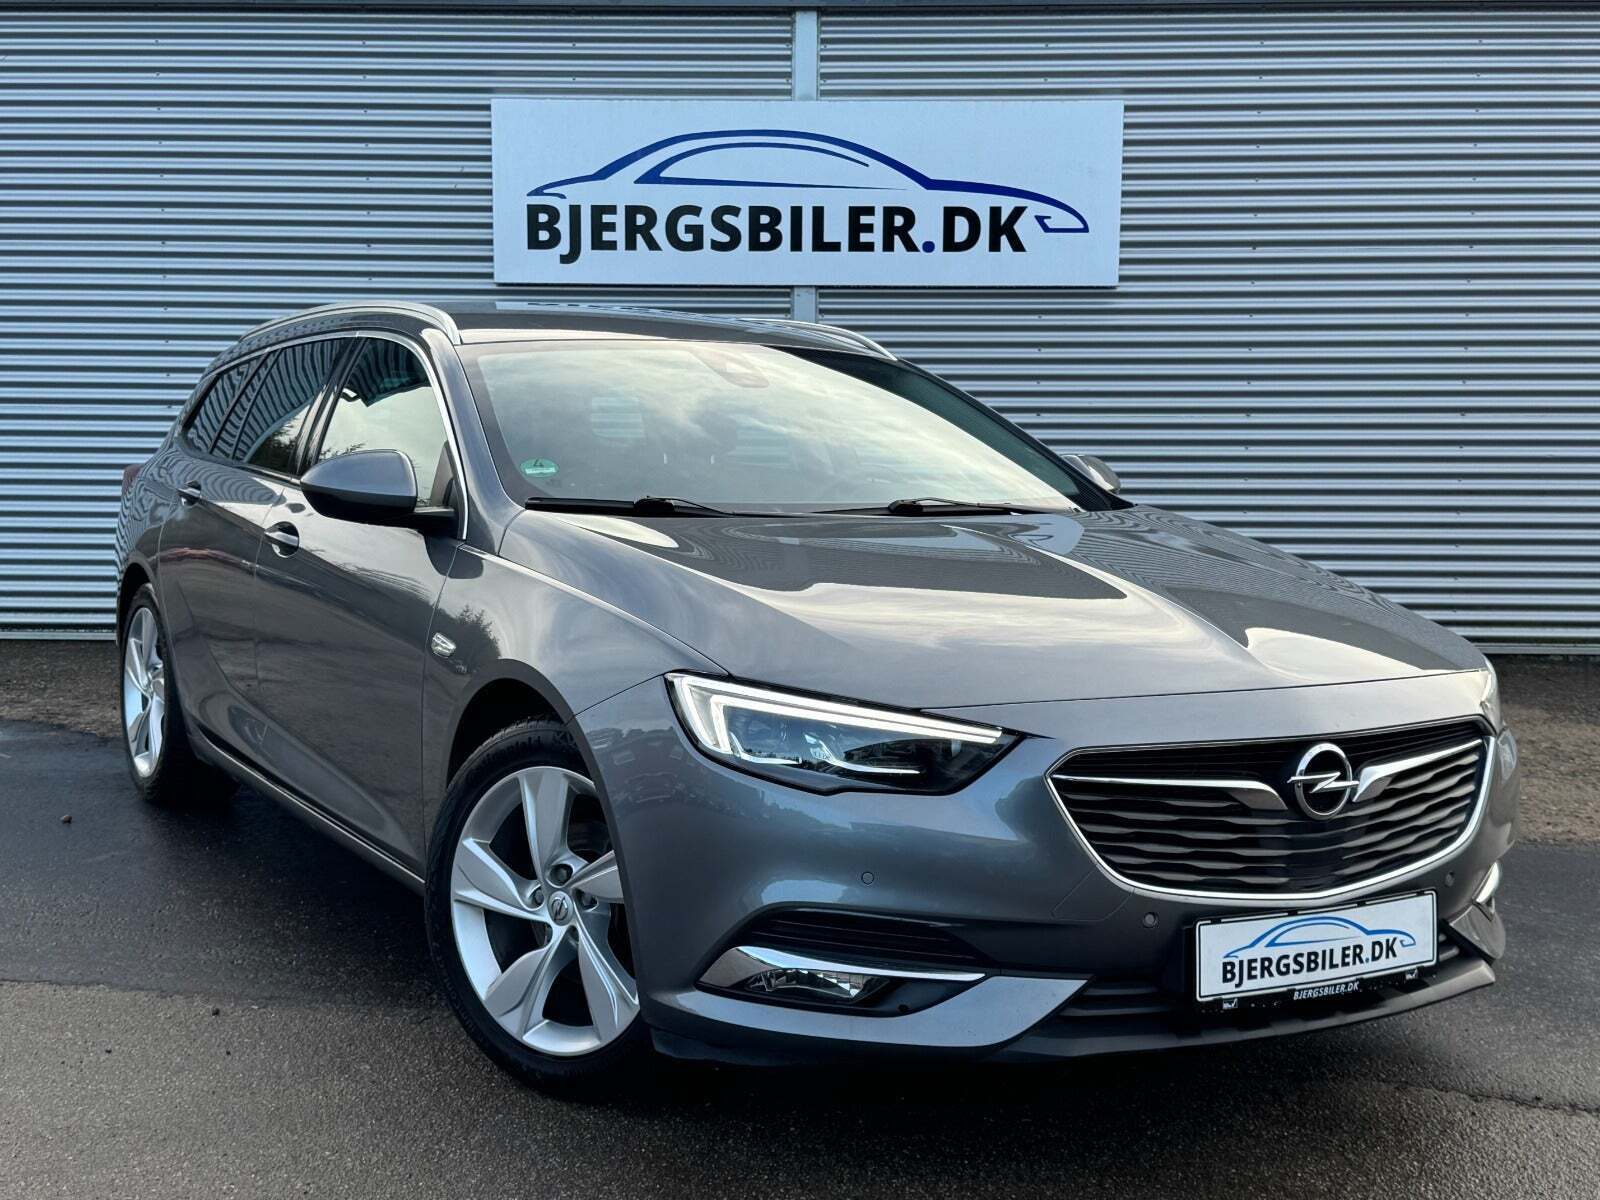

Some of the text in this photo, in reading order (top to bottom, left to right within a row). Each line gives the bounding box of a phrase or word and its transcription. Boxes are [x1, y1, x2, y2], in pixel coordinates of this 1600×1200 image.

[527, 203, 1027, 264] BJERGSBILER.DK
[1222, 937, 1398, 988] BJERGSBILER.DK
[1293, 981, 1360, 1000] BJERGSBILER.DK
